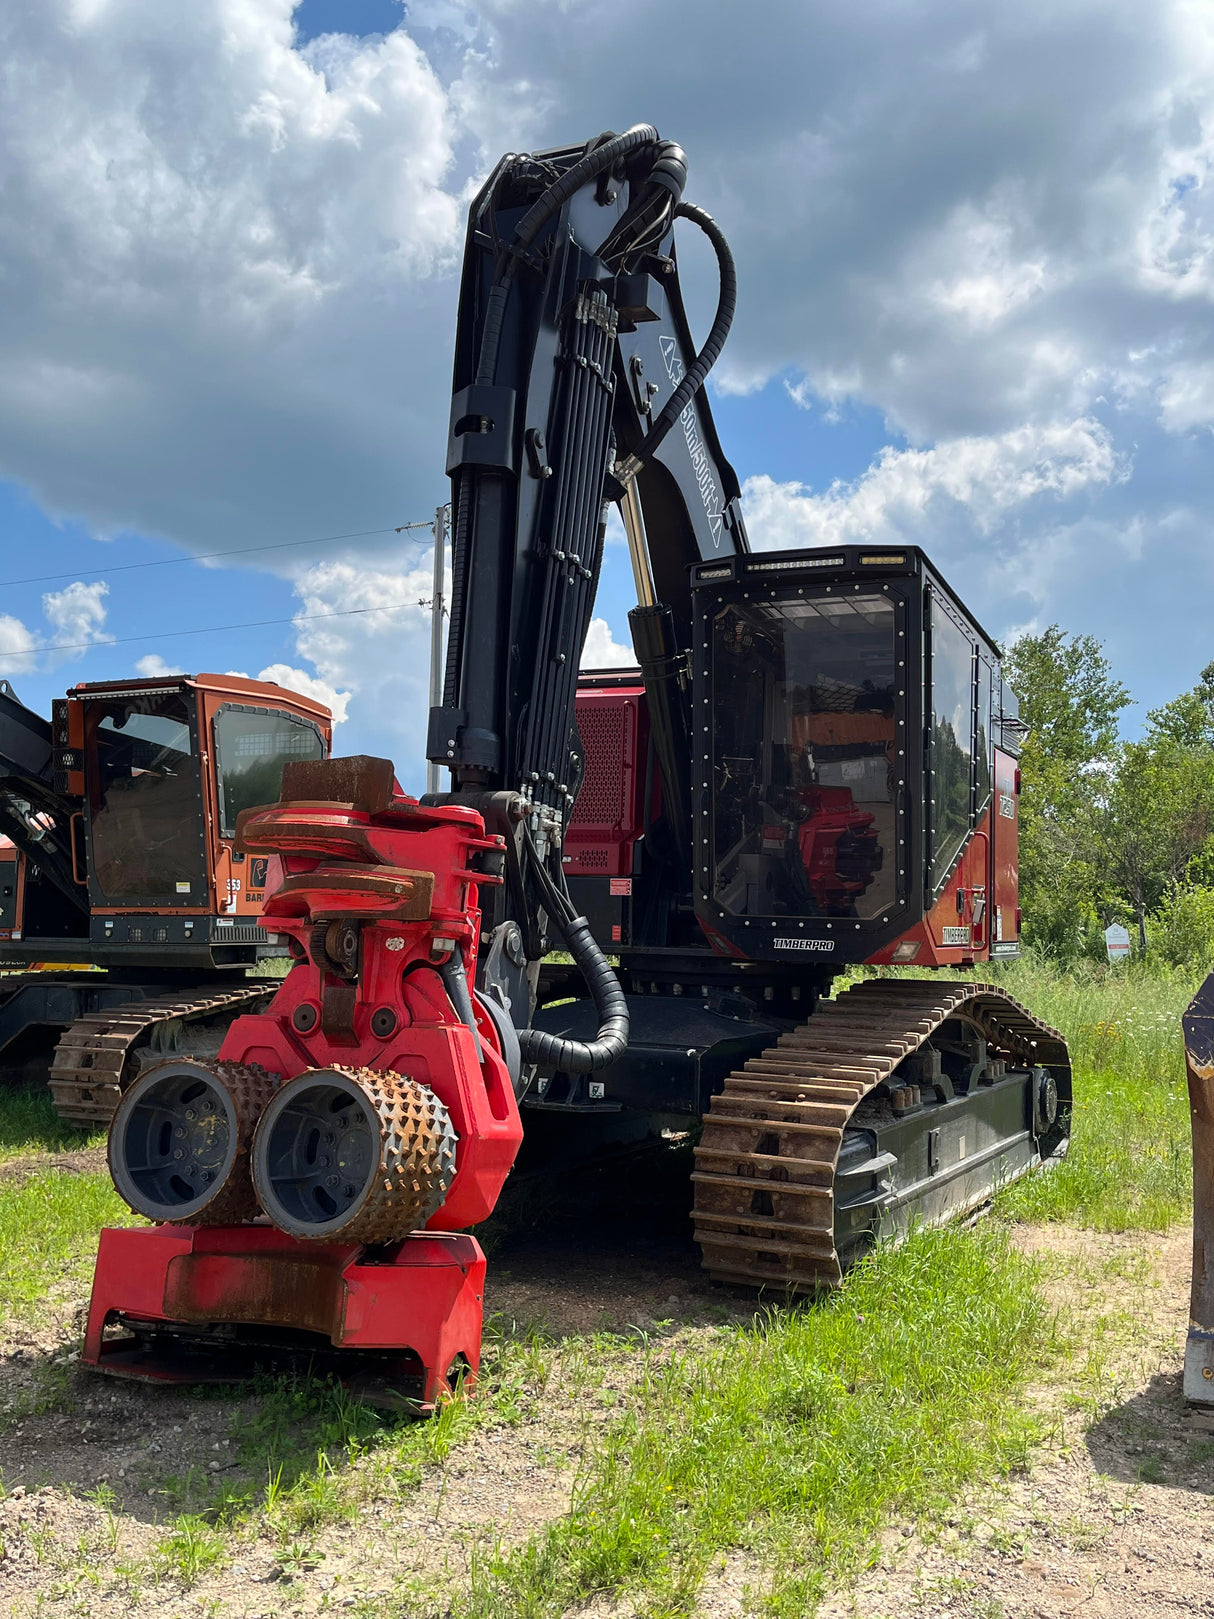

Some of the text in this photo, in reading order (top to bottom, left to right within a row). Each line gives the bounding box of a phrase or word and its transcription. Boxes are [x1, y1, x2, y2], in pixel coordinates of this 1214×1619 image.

[226, 878, 241, 891] 353
[246, 893, 265, 902] BAR
[942, 926, 970, 944] TIMBERPRO
[774, 938, 835, 951] TIMBERPRO
